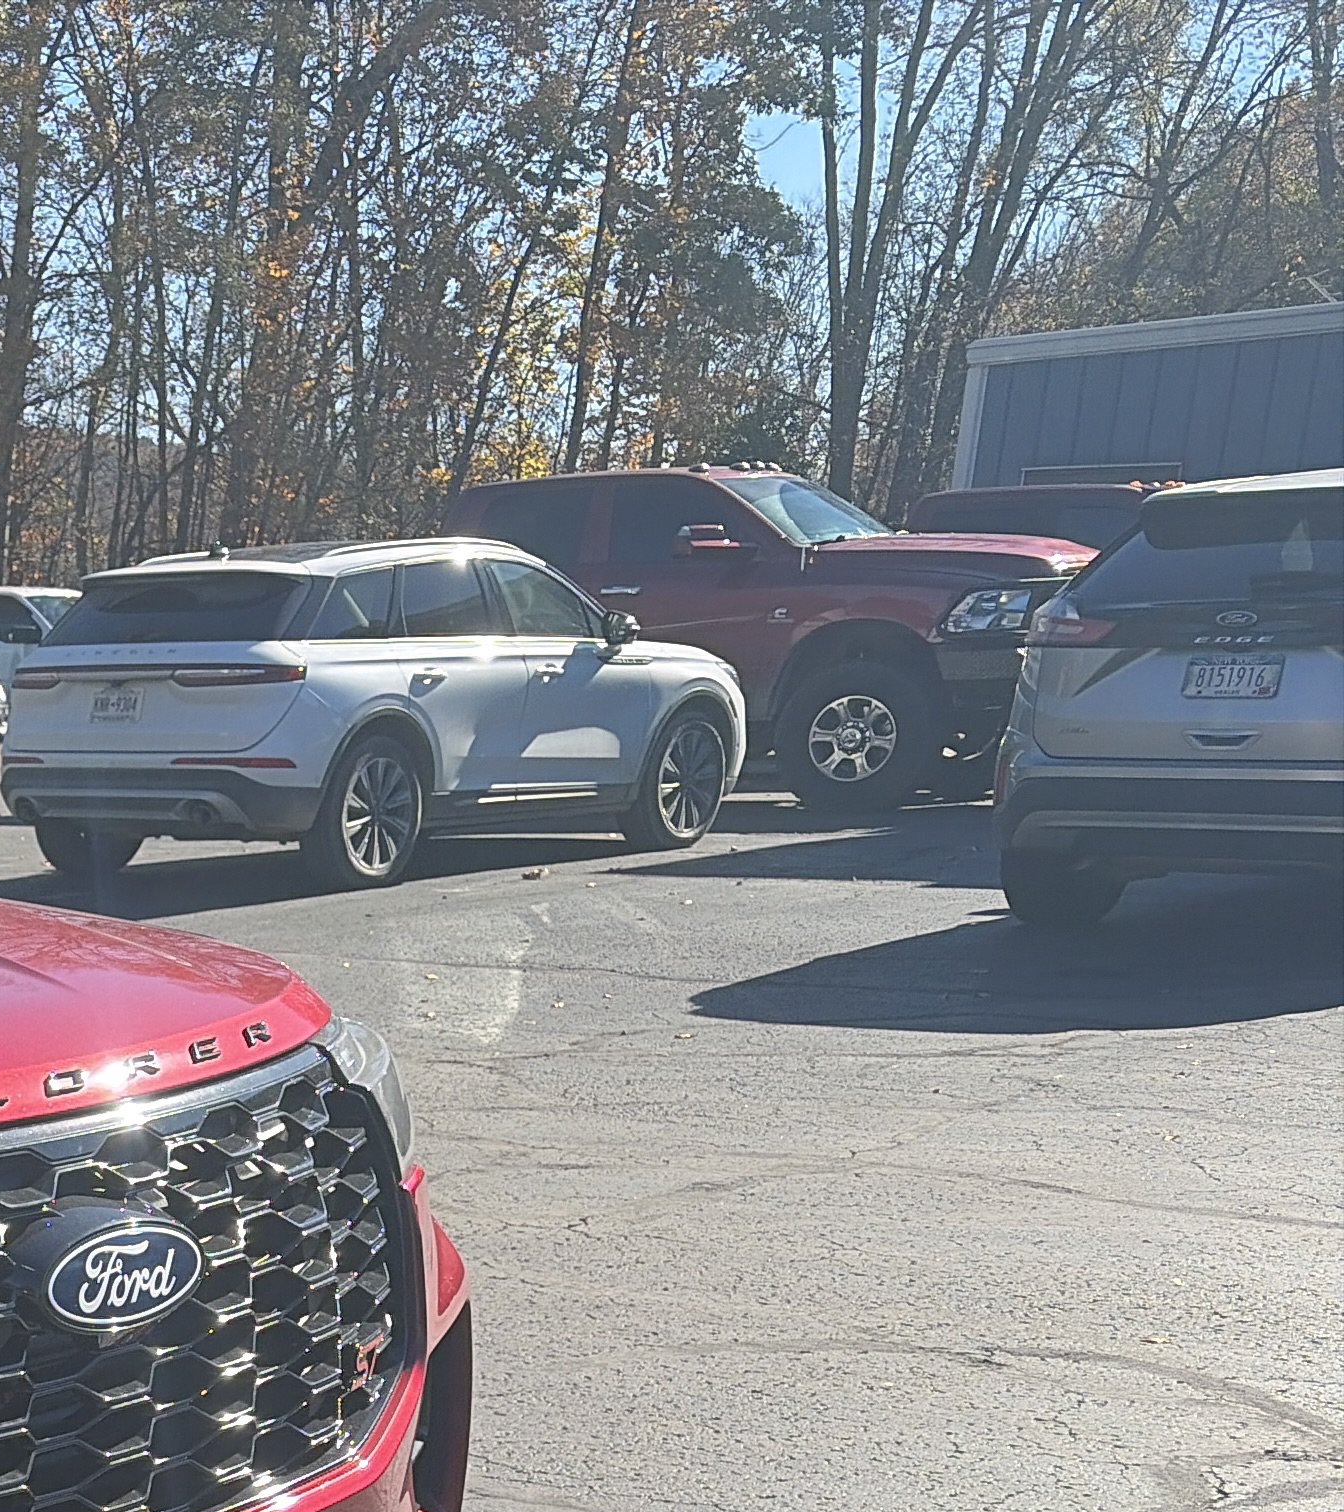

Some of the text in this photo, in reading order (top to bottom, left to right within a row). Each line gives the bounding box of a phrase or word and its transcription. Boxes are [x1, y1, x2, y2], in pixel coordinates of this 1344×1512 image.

[1194, 635, 1274, 643] EDGE
[1194, 666, 1267, 688] 8151916
[77, 1240, 176, 1314] Ford
